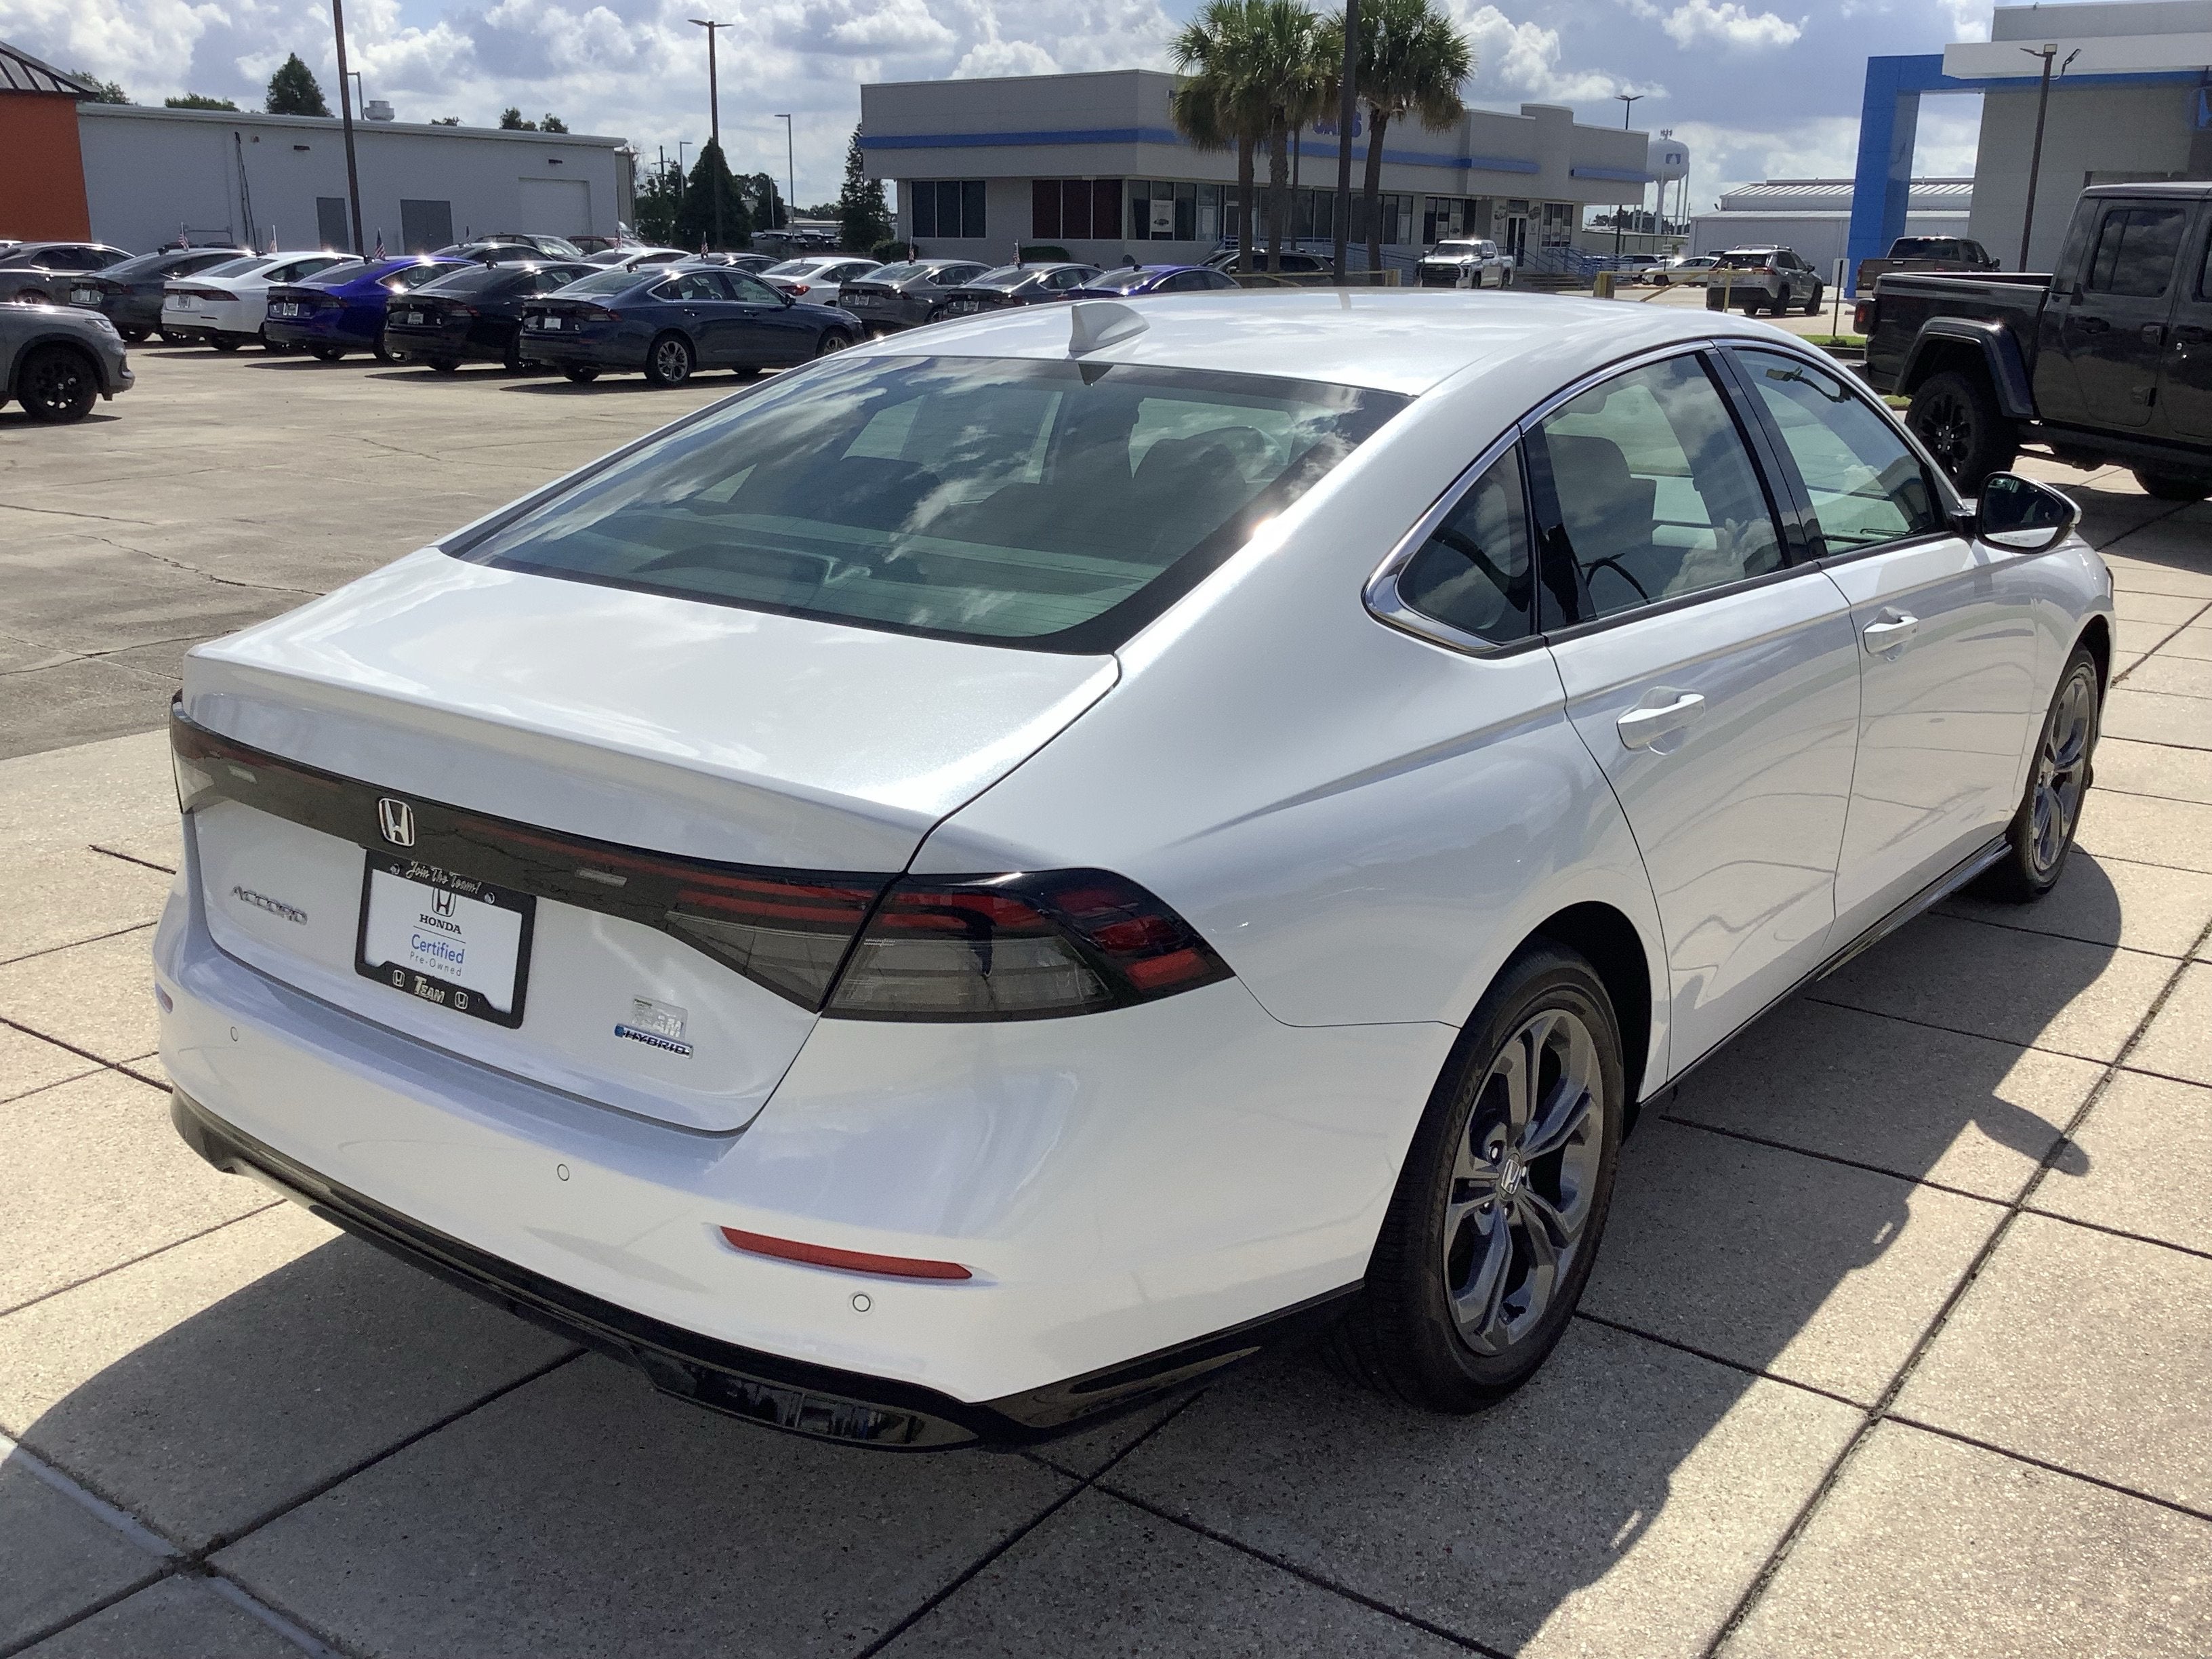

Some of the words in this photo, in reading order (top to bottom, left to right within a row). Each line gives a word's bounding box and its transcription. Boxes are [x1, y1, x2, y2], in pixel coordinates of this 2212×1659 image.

[406, 860, 429, 879] Join
[431, 865, 448, 884] The
[230, 885, 308, 926] ACCORD
[419, 914, 462, 935] HONDA
[411, 934, 465, 964] Certified
[409, 951, 462, 977] Pre-Owned
[623, 1029, 689, 1055] HYBRID
